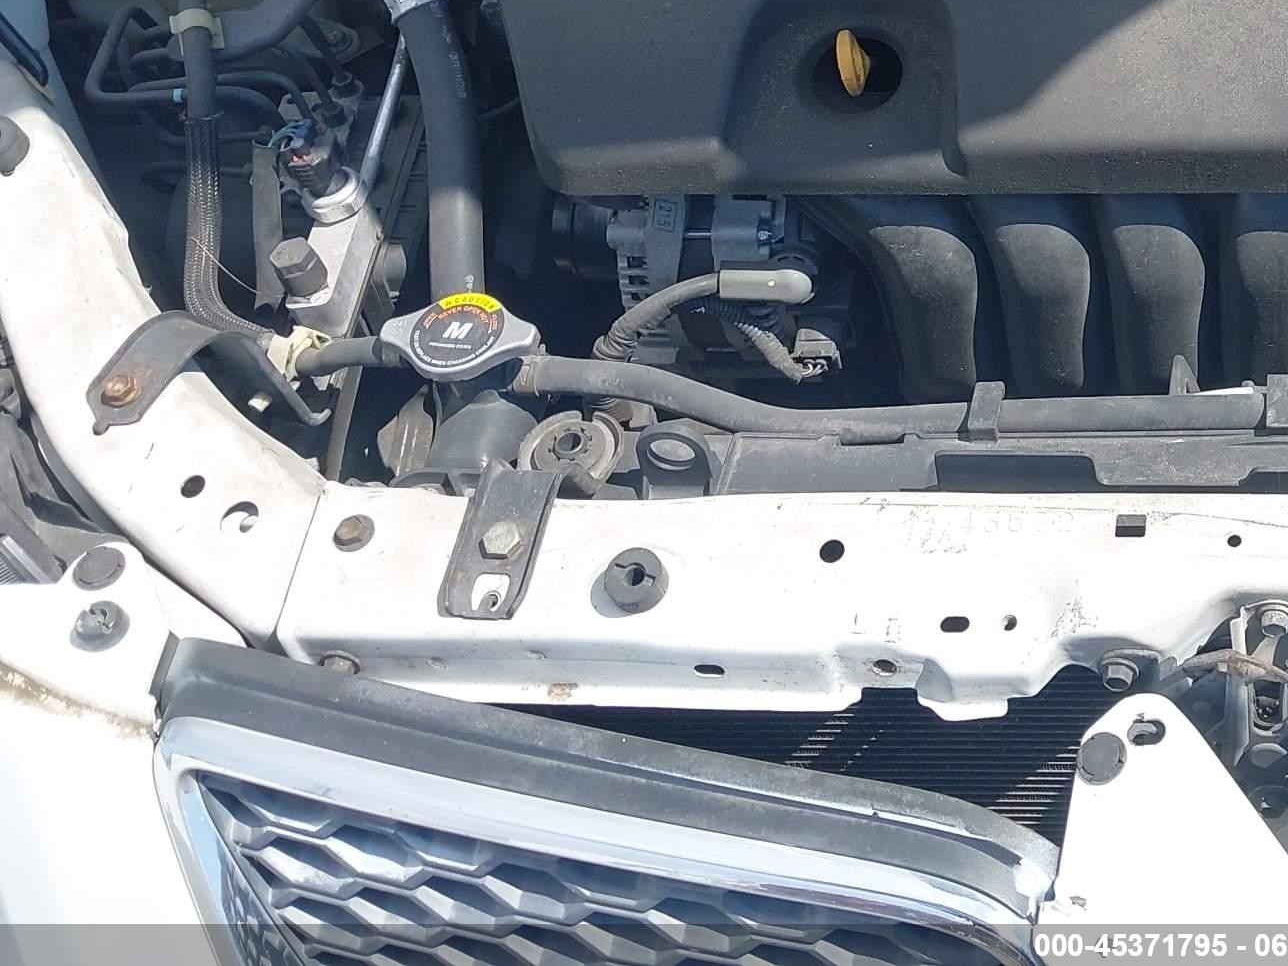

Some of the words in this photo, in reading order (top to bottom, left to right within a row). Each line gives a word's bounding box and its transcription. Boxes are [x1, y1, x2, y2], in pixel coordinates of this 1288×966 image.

[455, 297, 496, 309] CAUTION
[438, 306, 462, 319] NEVER
[442, 321, 474, 339] M
